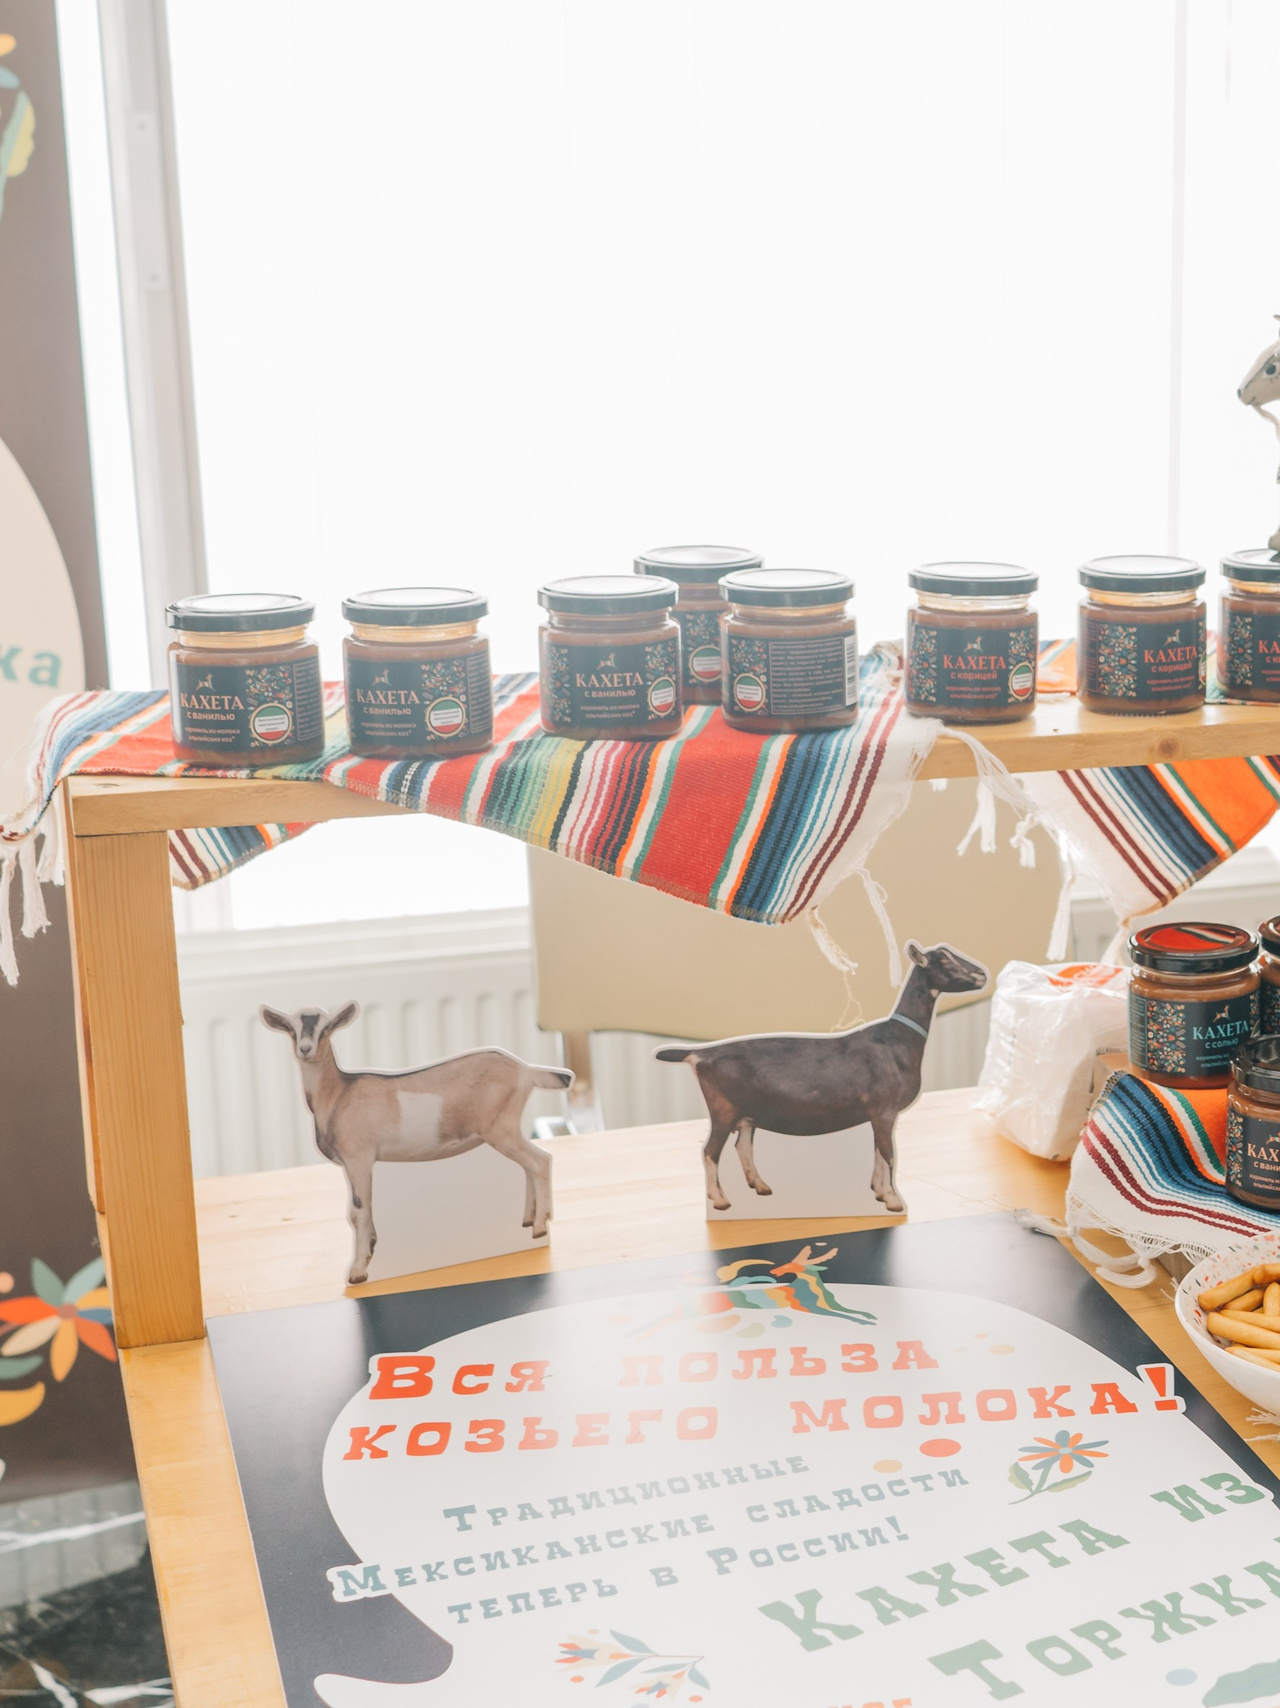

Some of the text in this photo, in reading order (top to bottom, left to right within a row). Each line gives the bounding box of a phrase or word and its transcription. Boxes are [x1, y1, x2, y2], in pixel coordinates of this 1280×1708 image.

[1144, 646, 1198, 664] КАХЕТА
[943, 654, 1007, 670] КАХЕТА
[575, 672, 644, 688] КАХЕТА
[957, 670, 998, 681] корицей
[356, 689, 420, 705] КАХЕТА
[584, 689, 636, 698] с ванилью
[180, 692, 245, 710] КАХЕТА
[186, 711, 236, 721] с ванилью
[369, 707, 412, 716] ванилью
[1192, 1020, 1249, 1041] КАХЕТА
[1205, 1038, 1239, 1049] с солью
[1253, 1160, 1260, 1168] с
